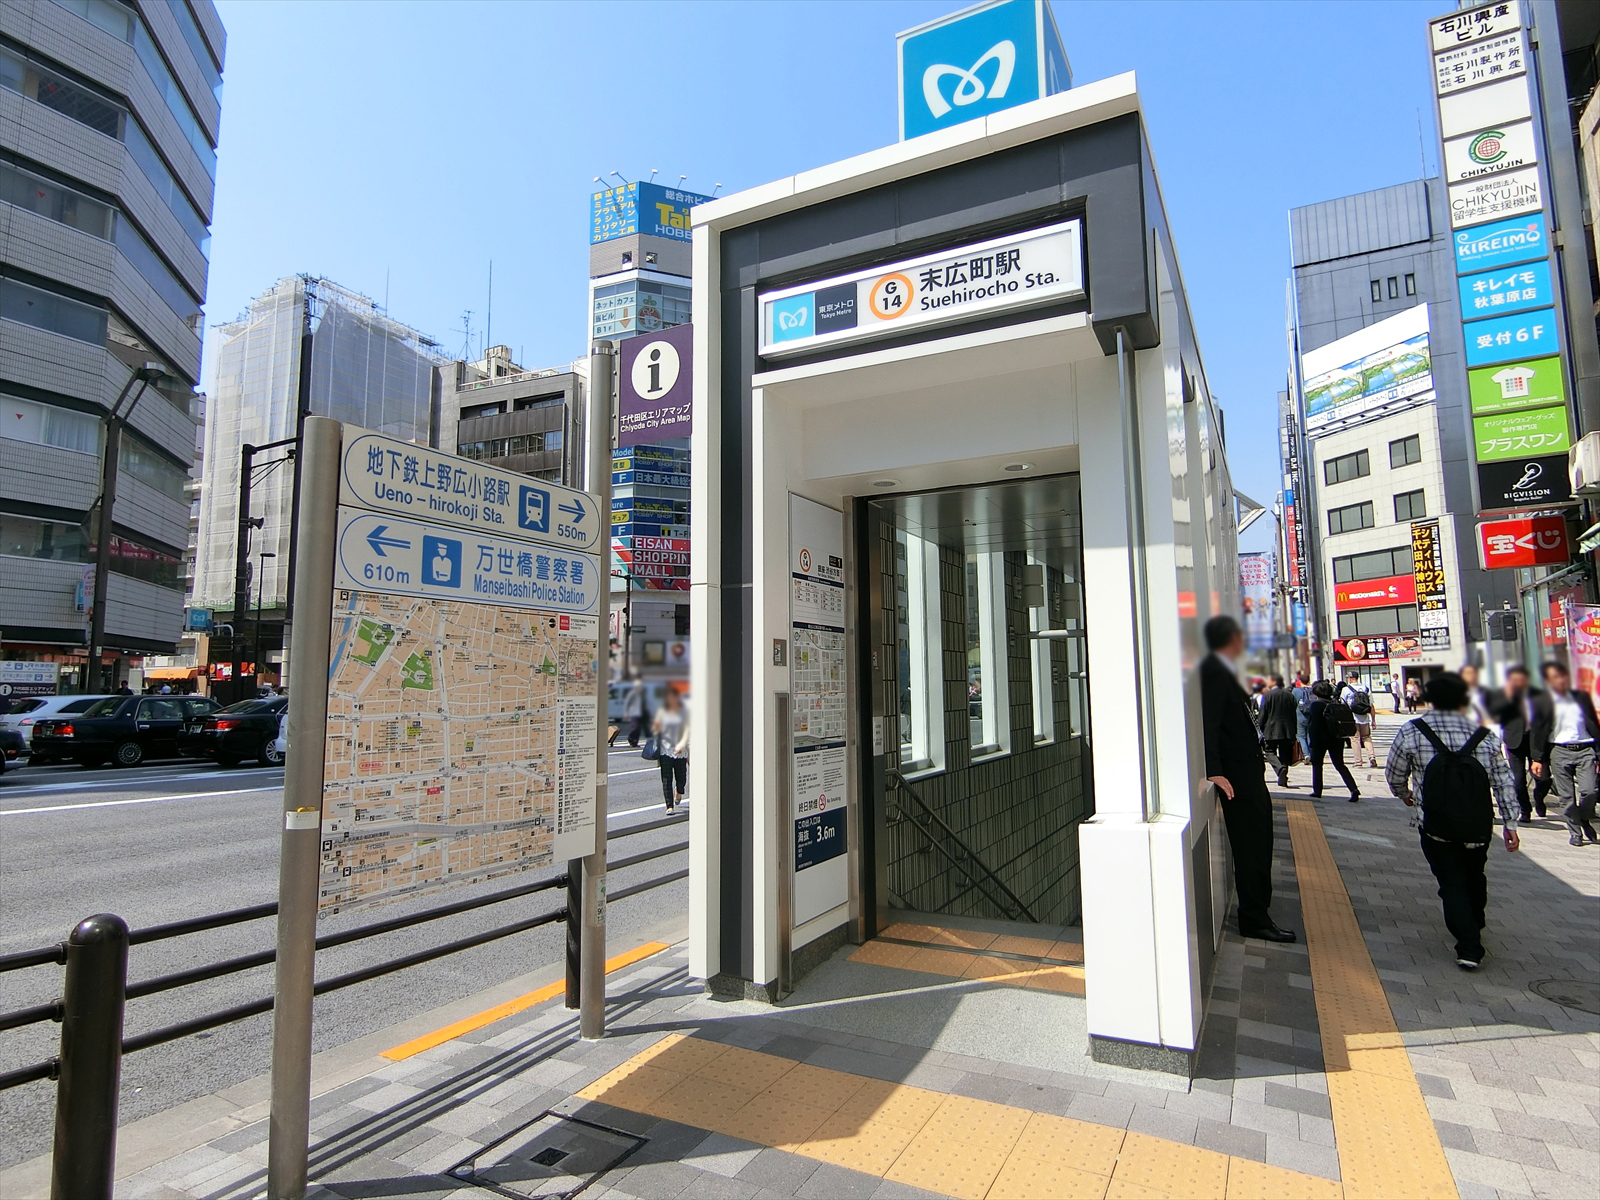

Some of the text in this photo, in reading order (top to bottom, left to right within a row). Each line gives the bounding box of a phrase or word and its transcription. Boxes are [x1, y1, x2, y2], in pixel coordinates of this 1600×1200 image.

[1439, 5, 1509, 33] 石川興産
[1456, 23, 1493, 41] ビル
[1452, 46, 1520, 72] 石川製作所
[1454, 60, 1521, 83] 石川興産
[1461, 158, 1523, 178] CHIKYUJIN
[1467, 177, 1518, 194] 一般財団法人
[665, 189, 706, 205] 総合ホビ
[1452, 182, 1537, 211] CHIKYUJIN
[1453, 195, 1538, 221] 留学生支援機構
[1458, 230, 1541, 257] KIREIMO
[919, 248, 1021, 293] 末広町駅
[885, 281, 897, 295] G
[920, 270, 1060, 312] Suehirocho Sta.
[1473, 271, 1535, 293] キレイモ
[818, 299, 854, 314] 東京メトロ
[882, 295, 903, 311] 14
[1474, 288, 1537, 309] 秋葉原店
[820, 308, 852, 320] Tokyo Metro
[620, 402, 691, 425] 千代田区エリアマップ
[620, 413, 691, 433] Chiyoda City Area Map
[612, 447, 634, 459] Model
[1480, 432, 1563, 455] プラスワン
[366, 444, 510, 507] 地下鉄上野広小路駅
[1504, 489, 1551, 499] BIGVISION
[482, 508, 505, 525] Sta.
[557, 524, 587, 542] 550m
[635, 537, 673, 550] EISAN
[1487, 529, 1561, 555] 宝くじ
[364, 562, 410, 585] 610m
[476, 544, 584, 586] 万世橋警察署
[634, 564, 670, 577] MALL
[474, 574, 585, 605] Manseibashi Police Station
[816, 825, 836, 843] 3.6m
